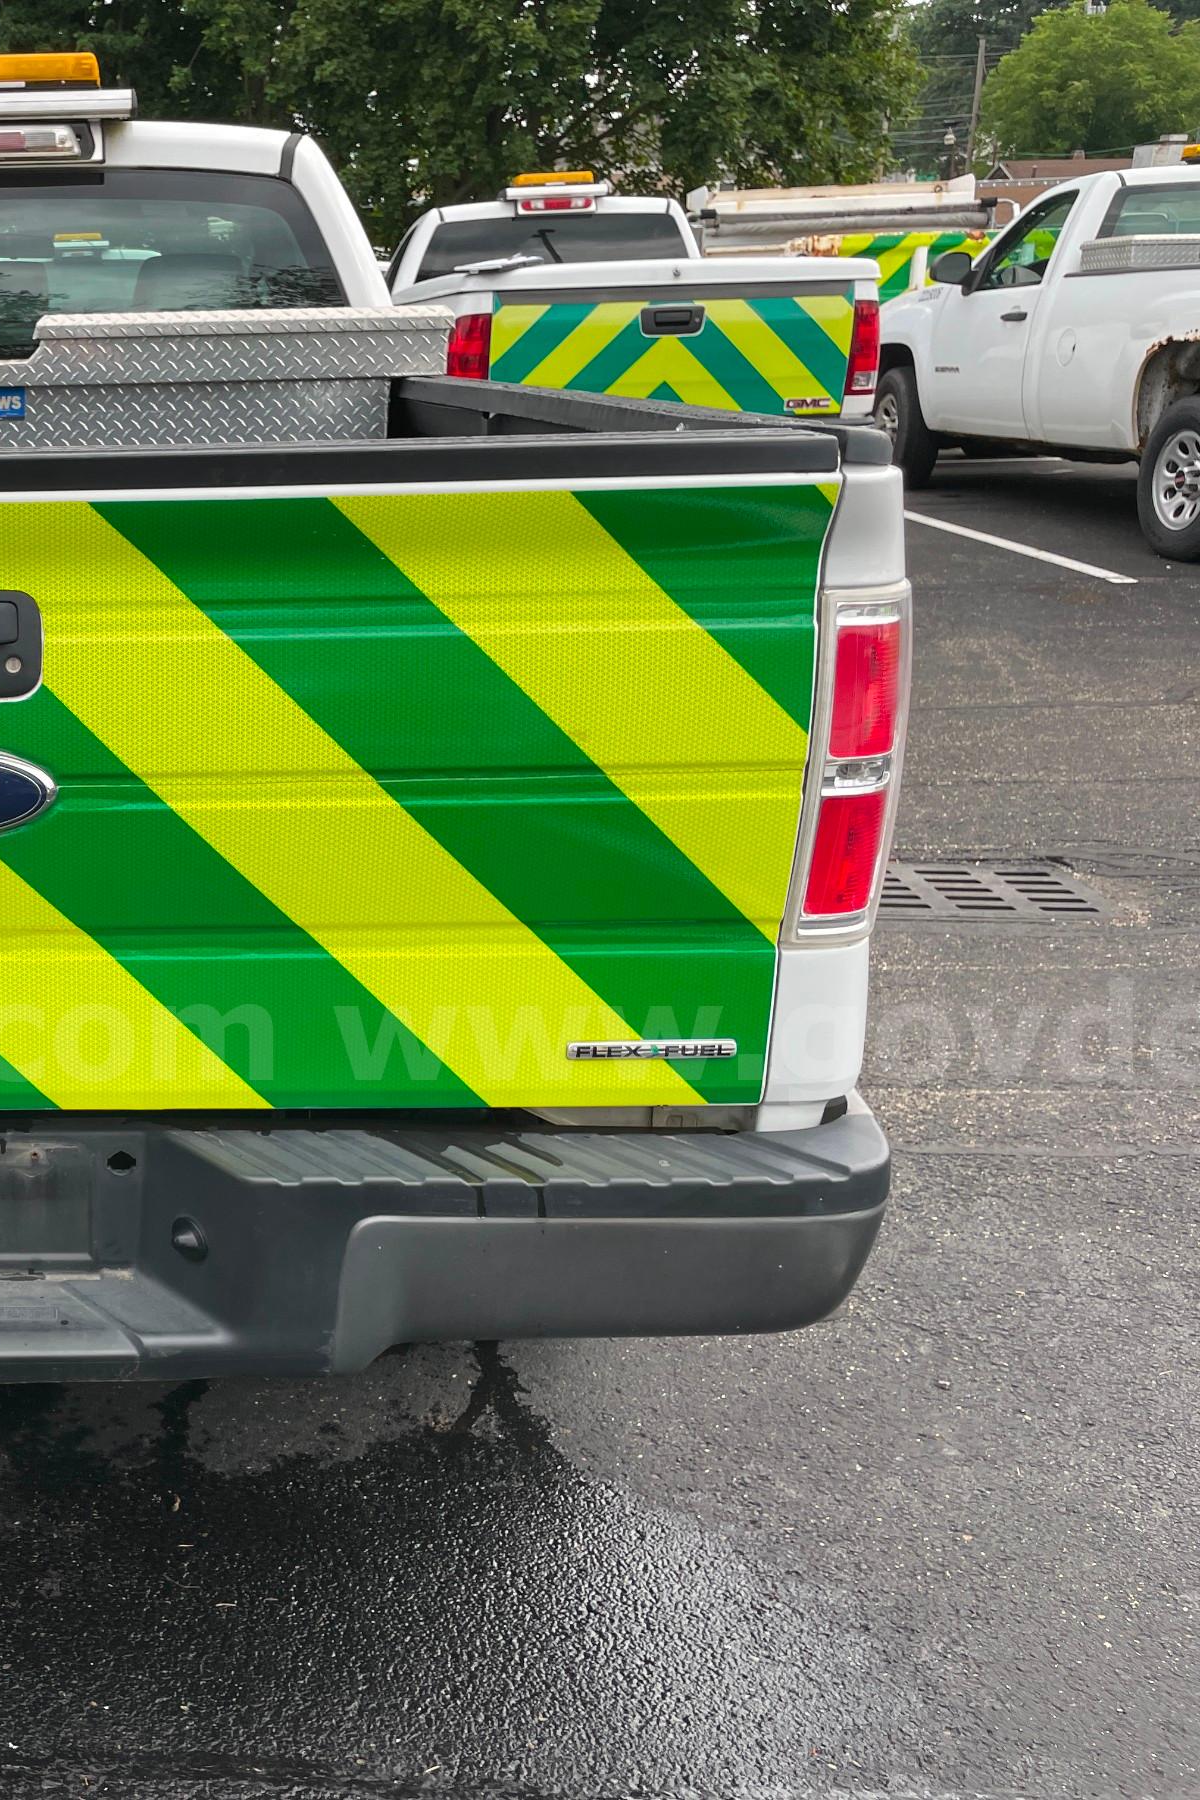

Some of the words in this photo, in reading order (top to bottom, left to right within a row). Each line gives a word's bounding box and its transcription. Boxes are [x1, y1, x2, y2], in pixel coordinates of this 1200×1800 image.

[785, 397, 832, 409] GMC
[574, 1045, 642, 1058] FLEX
[664, 1044, 735, 1057] FUEL
